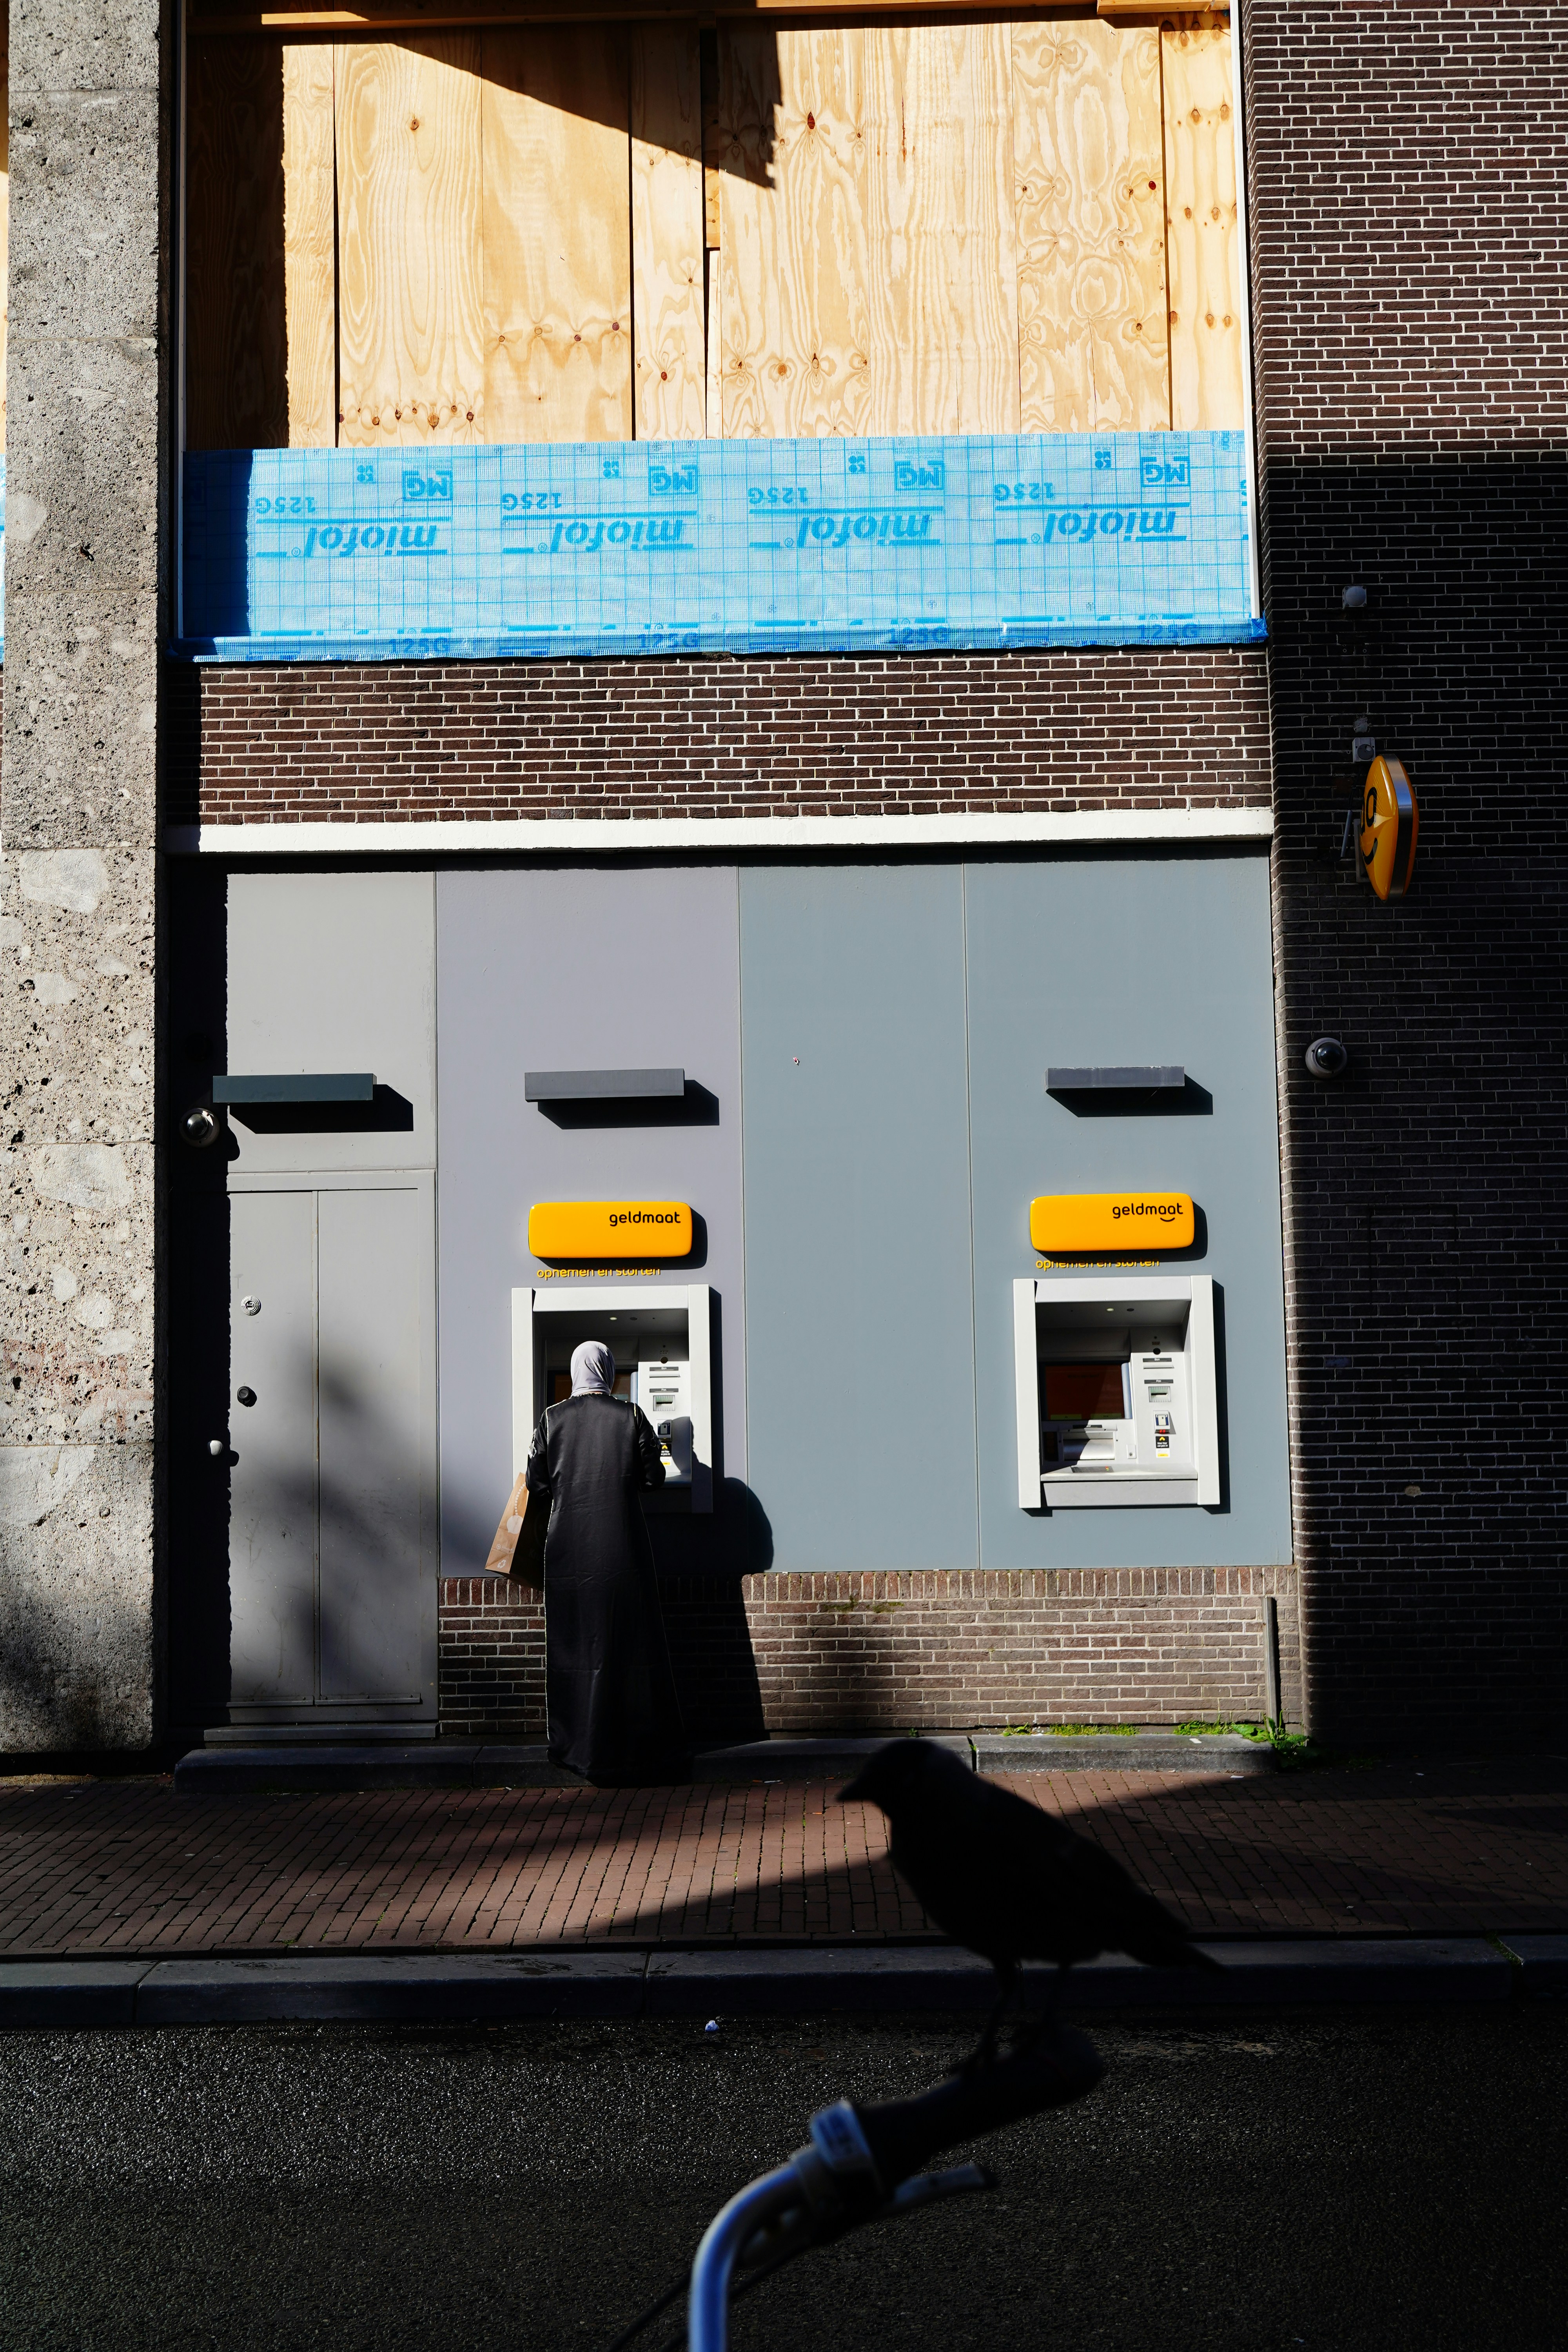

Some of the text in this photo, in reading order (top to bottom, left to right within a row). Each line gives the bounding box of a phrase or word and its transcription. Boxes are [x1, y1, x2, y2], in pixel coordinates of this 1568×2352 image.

[653, 473, 693, 491] MG
[899, 468, 940, 486] MG
[1145, 464, 1185, 483] MG
[406, 477, 448, 497] MG
[748, 487, 808, 504] 125G
[995, 483, 1056, 500] 125G
[255, 497, 316, 514] 125G
[502, 492, 562, 510] 125G
[797, 515, 930, 547] miofol
[1044, 511, 1176, 543] miofol
[304, 525, 437, 558] miofol
[550, 520, 683, 553] miofol
[610, 1211, 681, 1227] geldmaat
[1112, 1203, 1183, 1219] geldmaat
[1036, 1257, 1160, 1271] opnemen en storten
